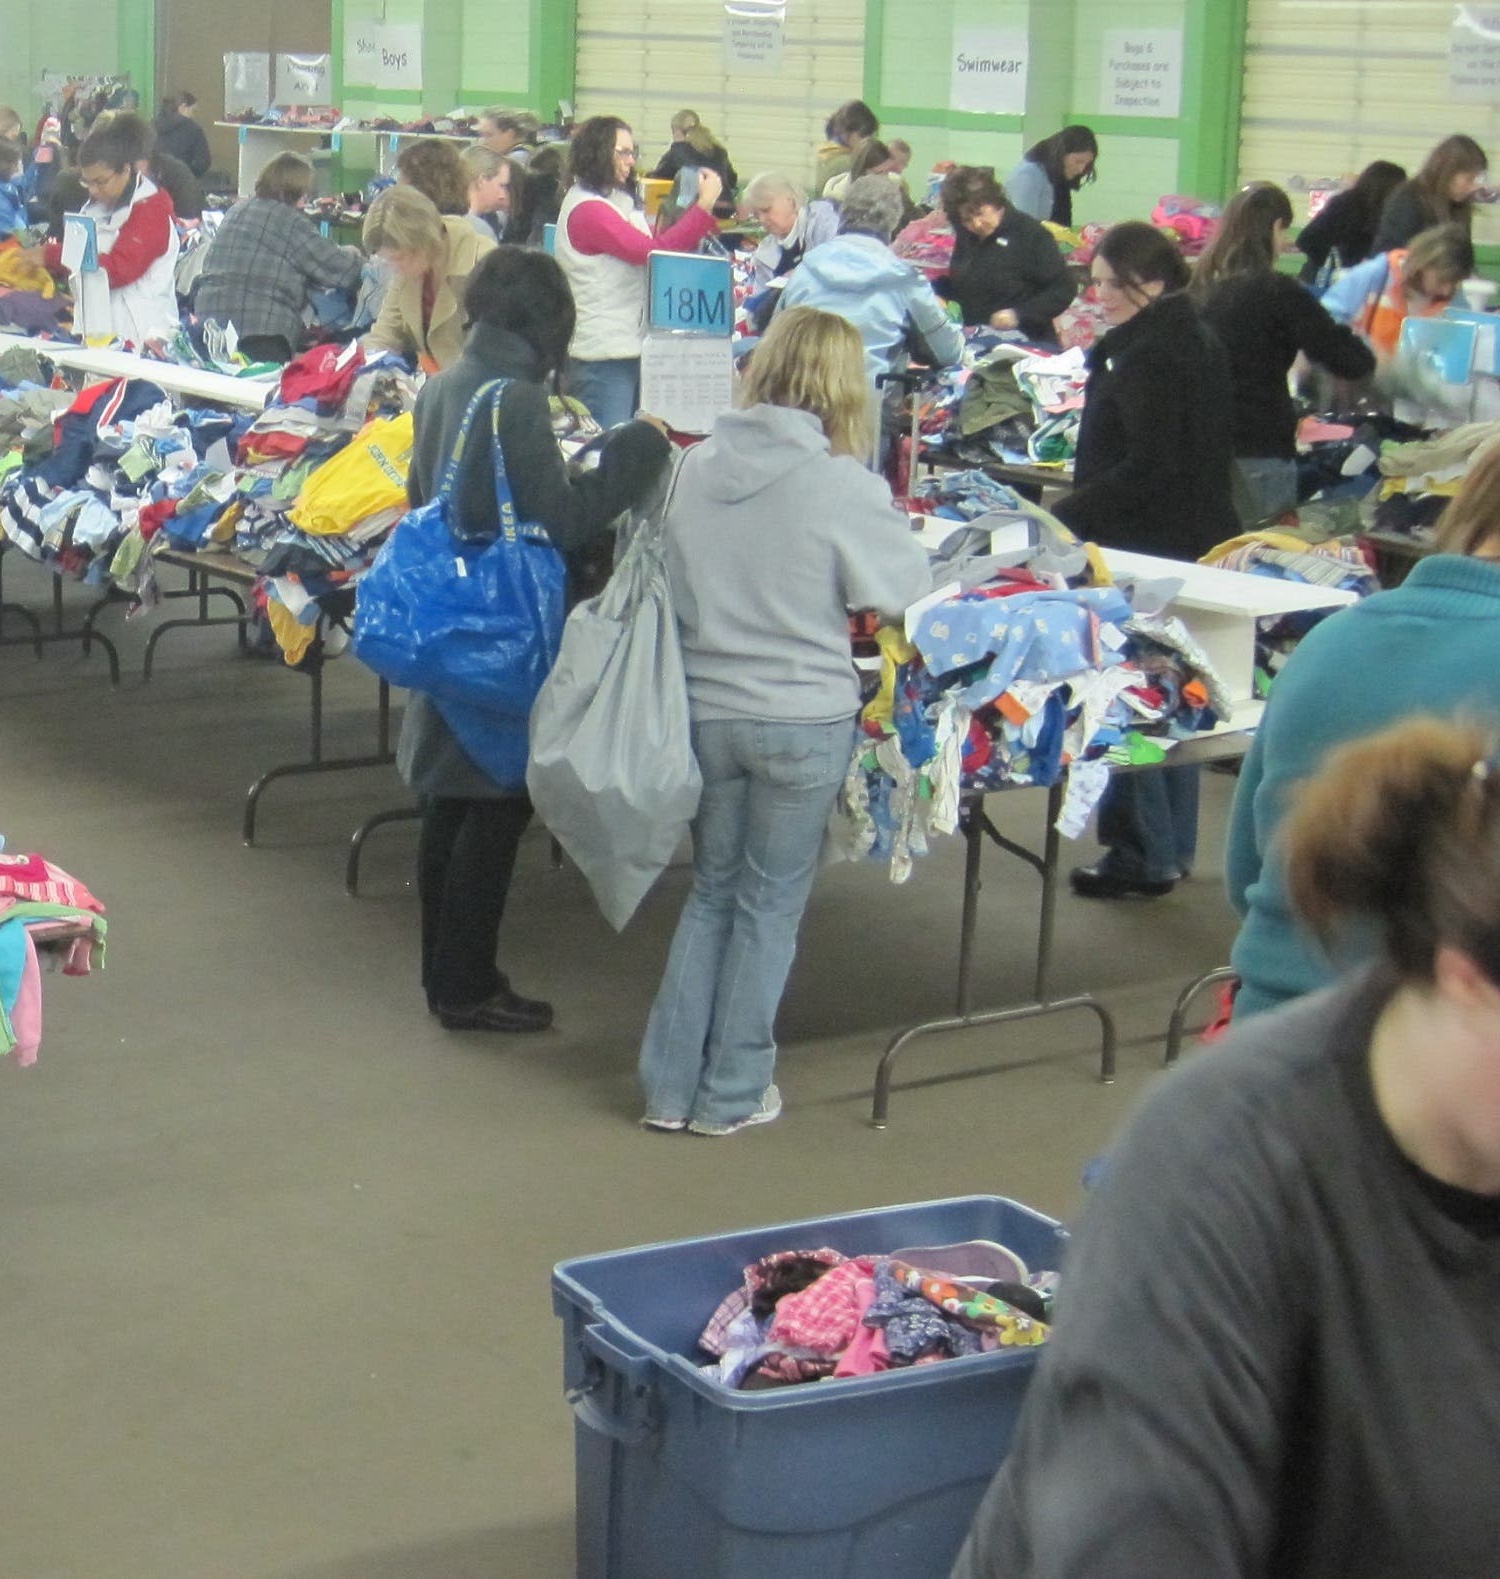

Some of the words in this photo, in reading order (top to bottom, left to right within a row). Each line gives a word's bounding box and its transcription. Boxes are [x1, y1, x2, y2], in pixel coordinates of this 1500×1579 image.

[382, 48, 407, 70] Boys
[957, 54, 1022, 73] Swimwear
[663, 286, 725, 325] 18M
[501, 502, 516, 542] IKEA
